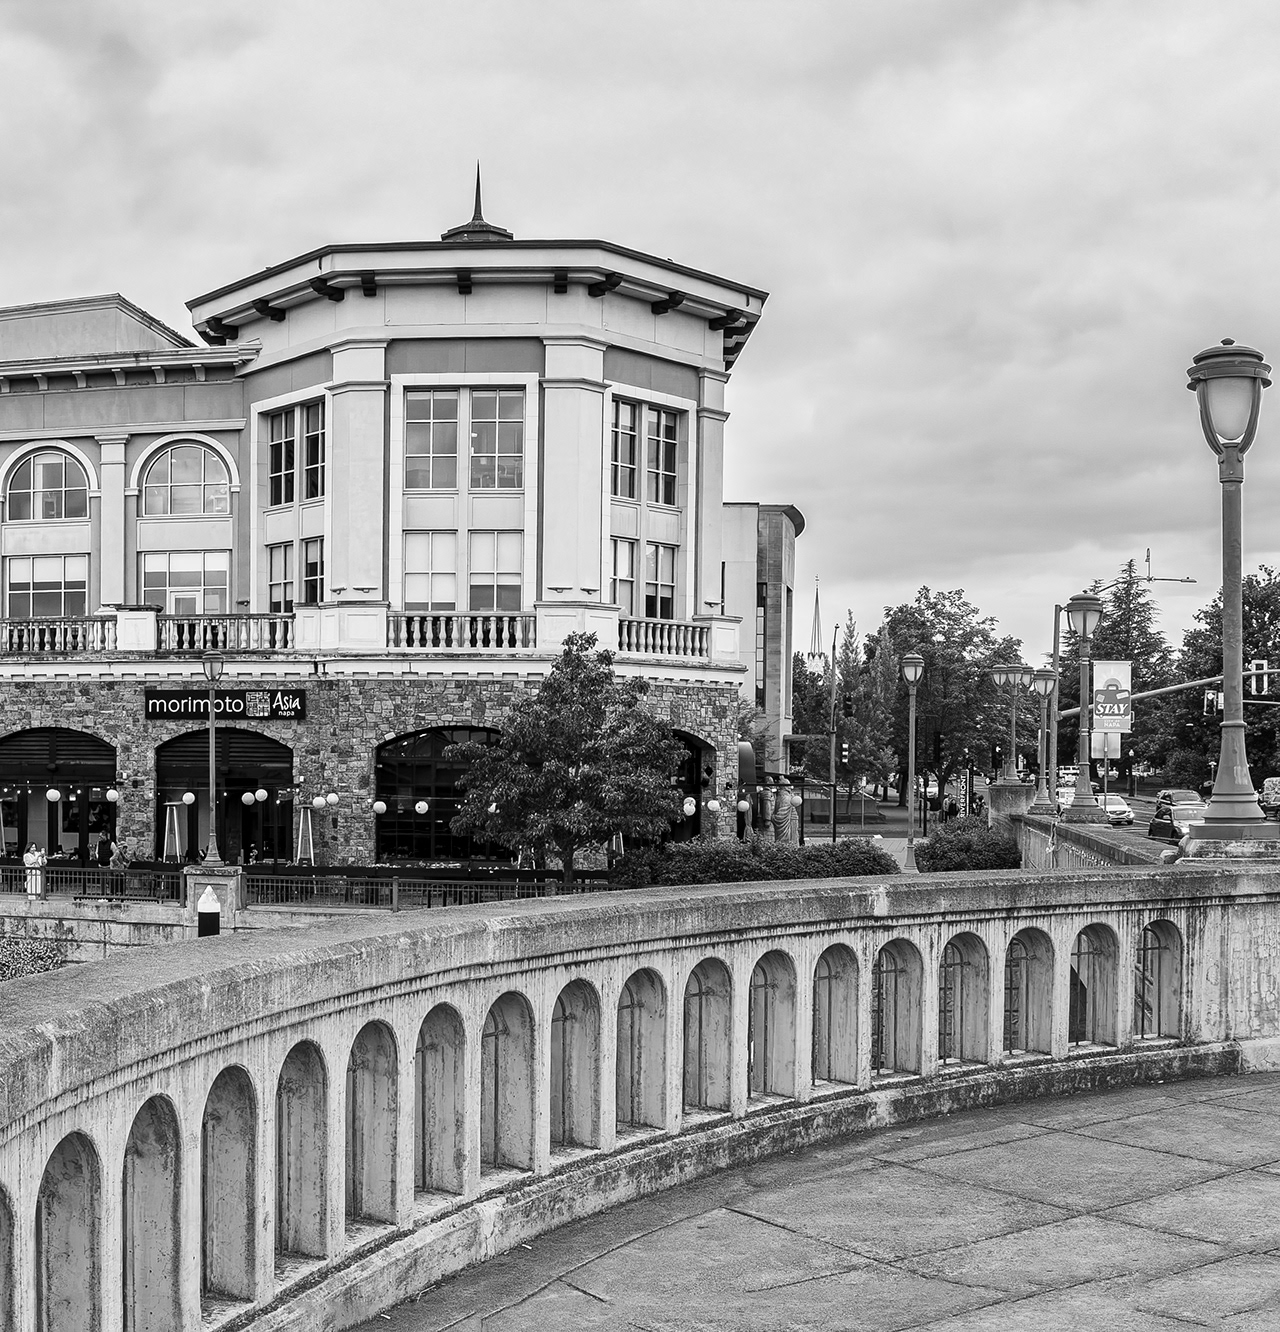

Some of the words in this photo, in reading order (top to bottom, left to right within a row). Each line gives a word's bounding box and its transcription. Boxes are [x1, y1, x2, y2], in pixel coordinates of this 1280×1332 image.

[149, 696, 244, 713] morimoto
[272, 691, 301, 710] Asia
[1096, 703, 1128, 714] STAY
